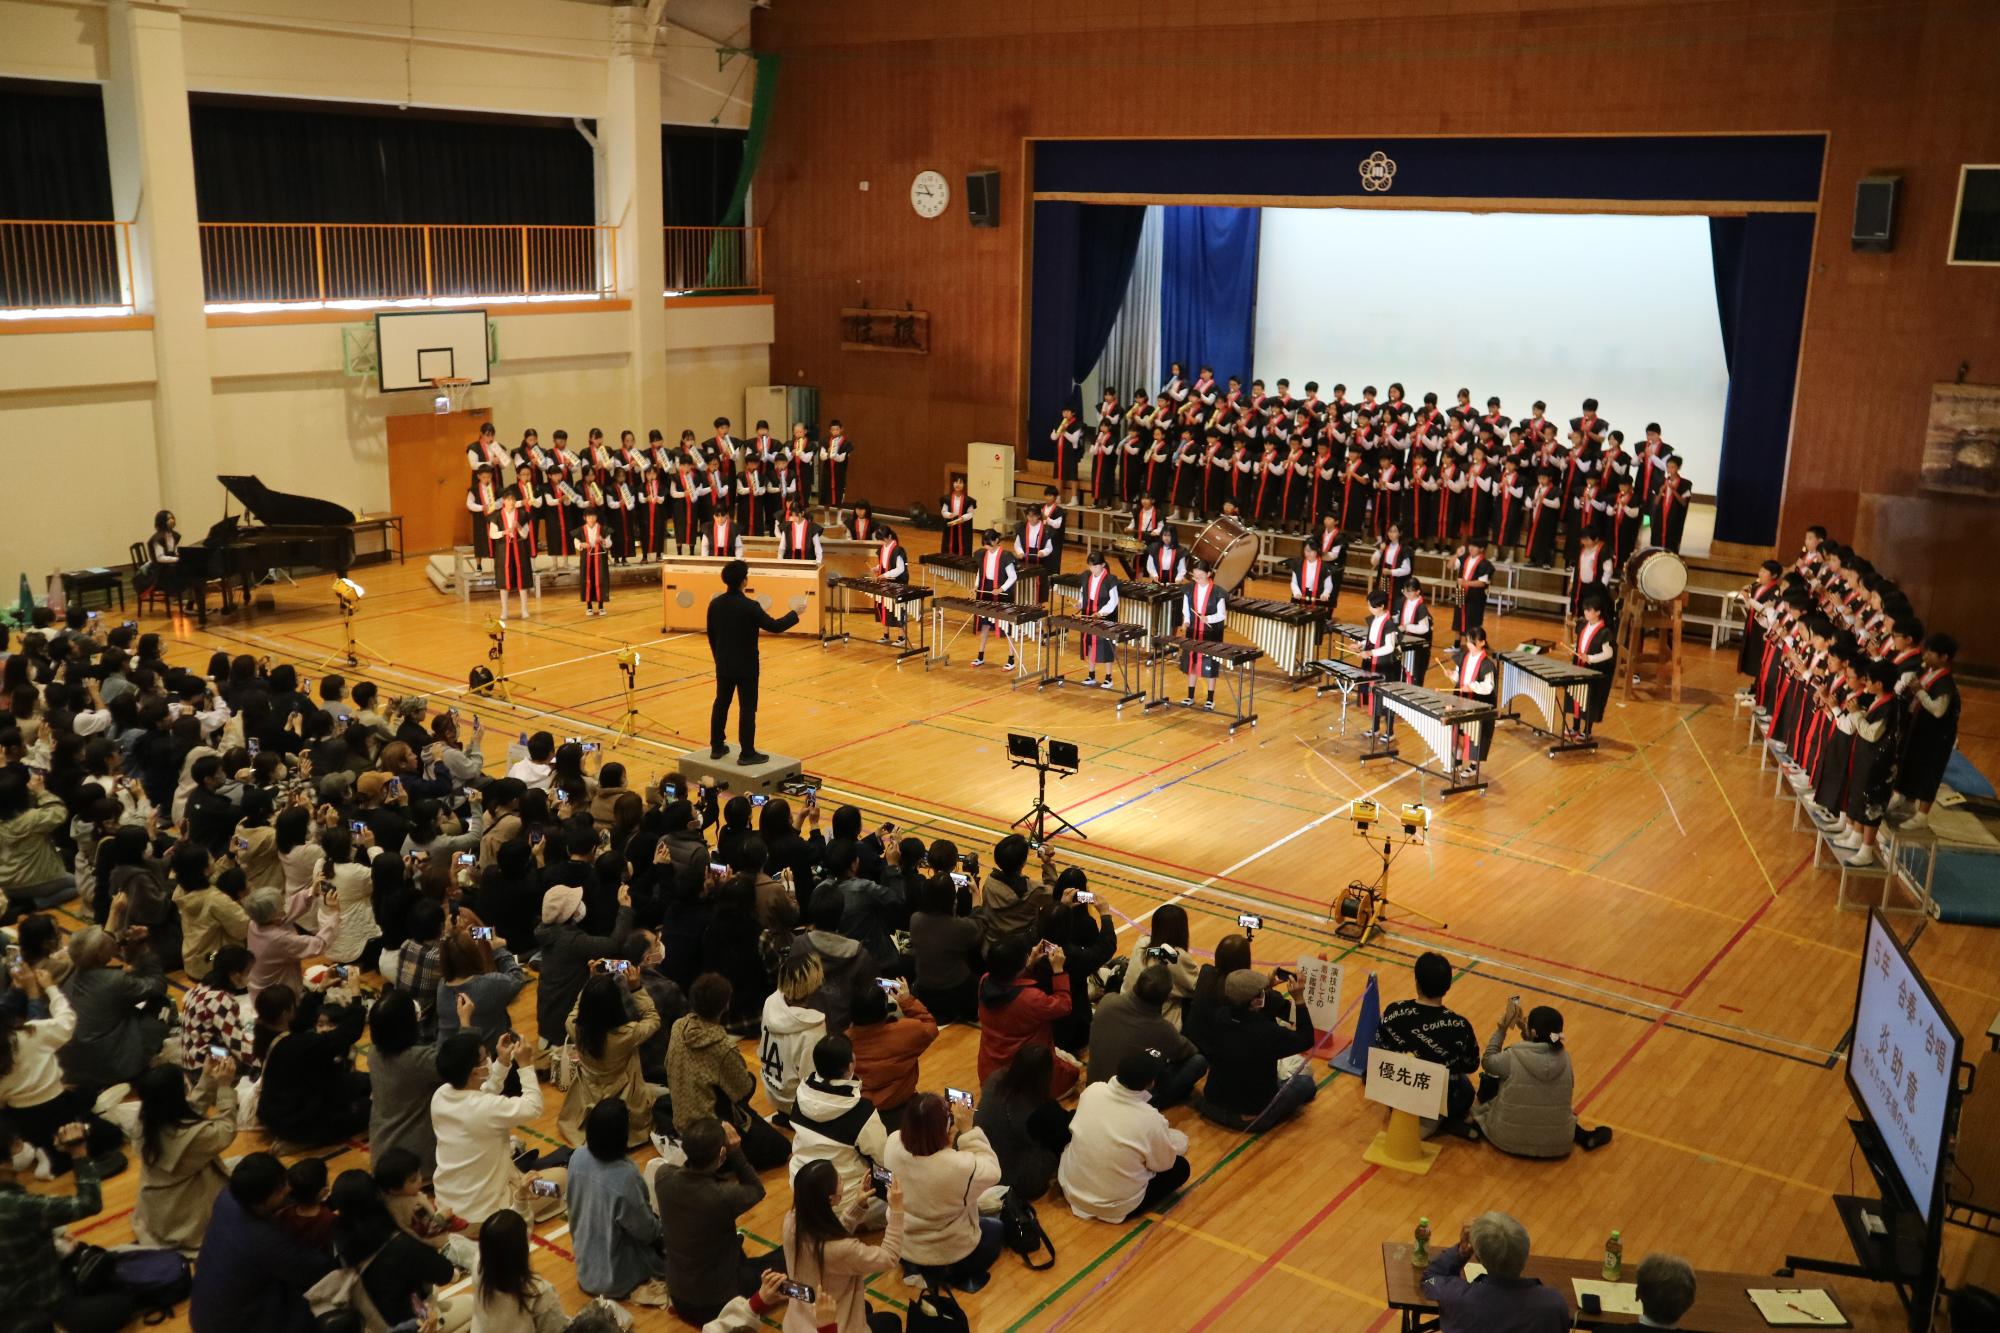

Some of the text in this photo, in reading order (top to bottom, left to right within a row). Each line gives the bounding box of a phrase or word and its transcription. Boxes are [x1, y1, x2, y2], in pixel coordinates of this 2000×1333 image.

[1316, 964, 1328, 1008] 着席しての
[1327, 967, 1339, 1004] 演技中は
[1384, 1007, 1419, 1023] COURAGE
[1422, 1019, 1466, 1031] COURAGE
[1873, 939, 1947, 1077] 5年 合奏・合唱
[761, 1025, 784, 1083] LA
[1411, 1028, 1449, 1057] COURAGE
[1378, 1060, 1432, 1091] 優先席
